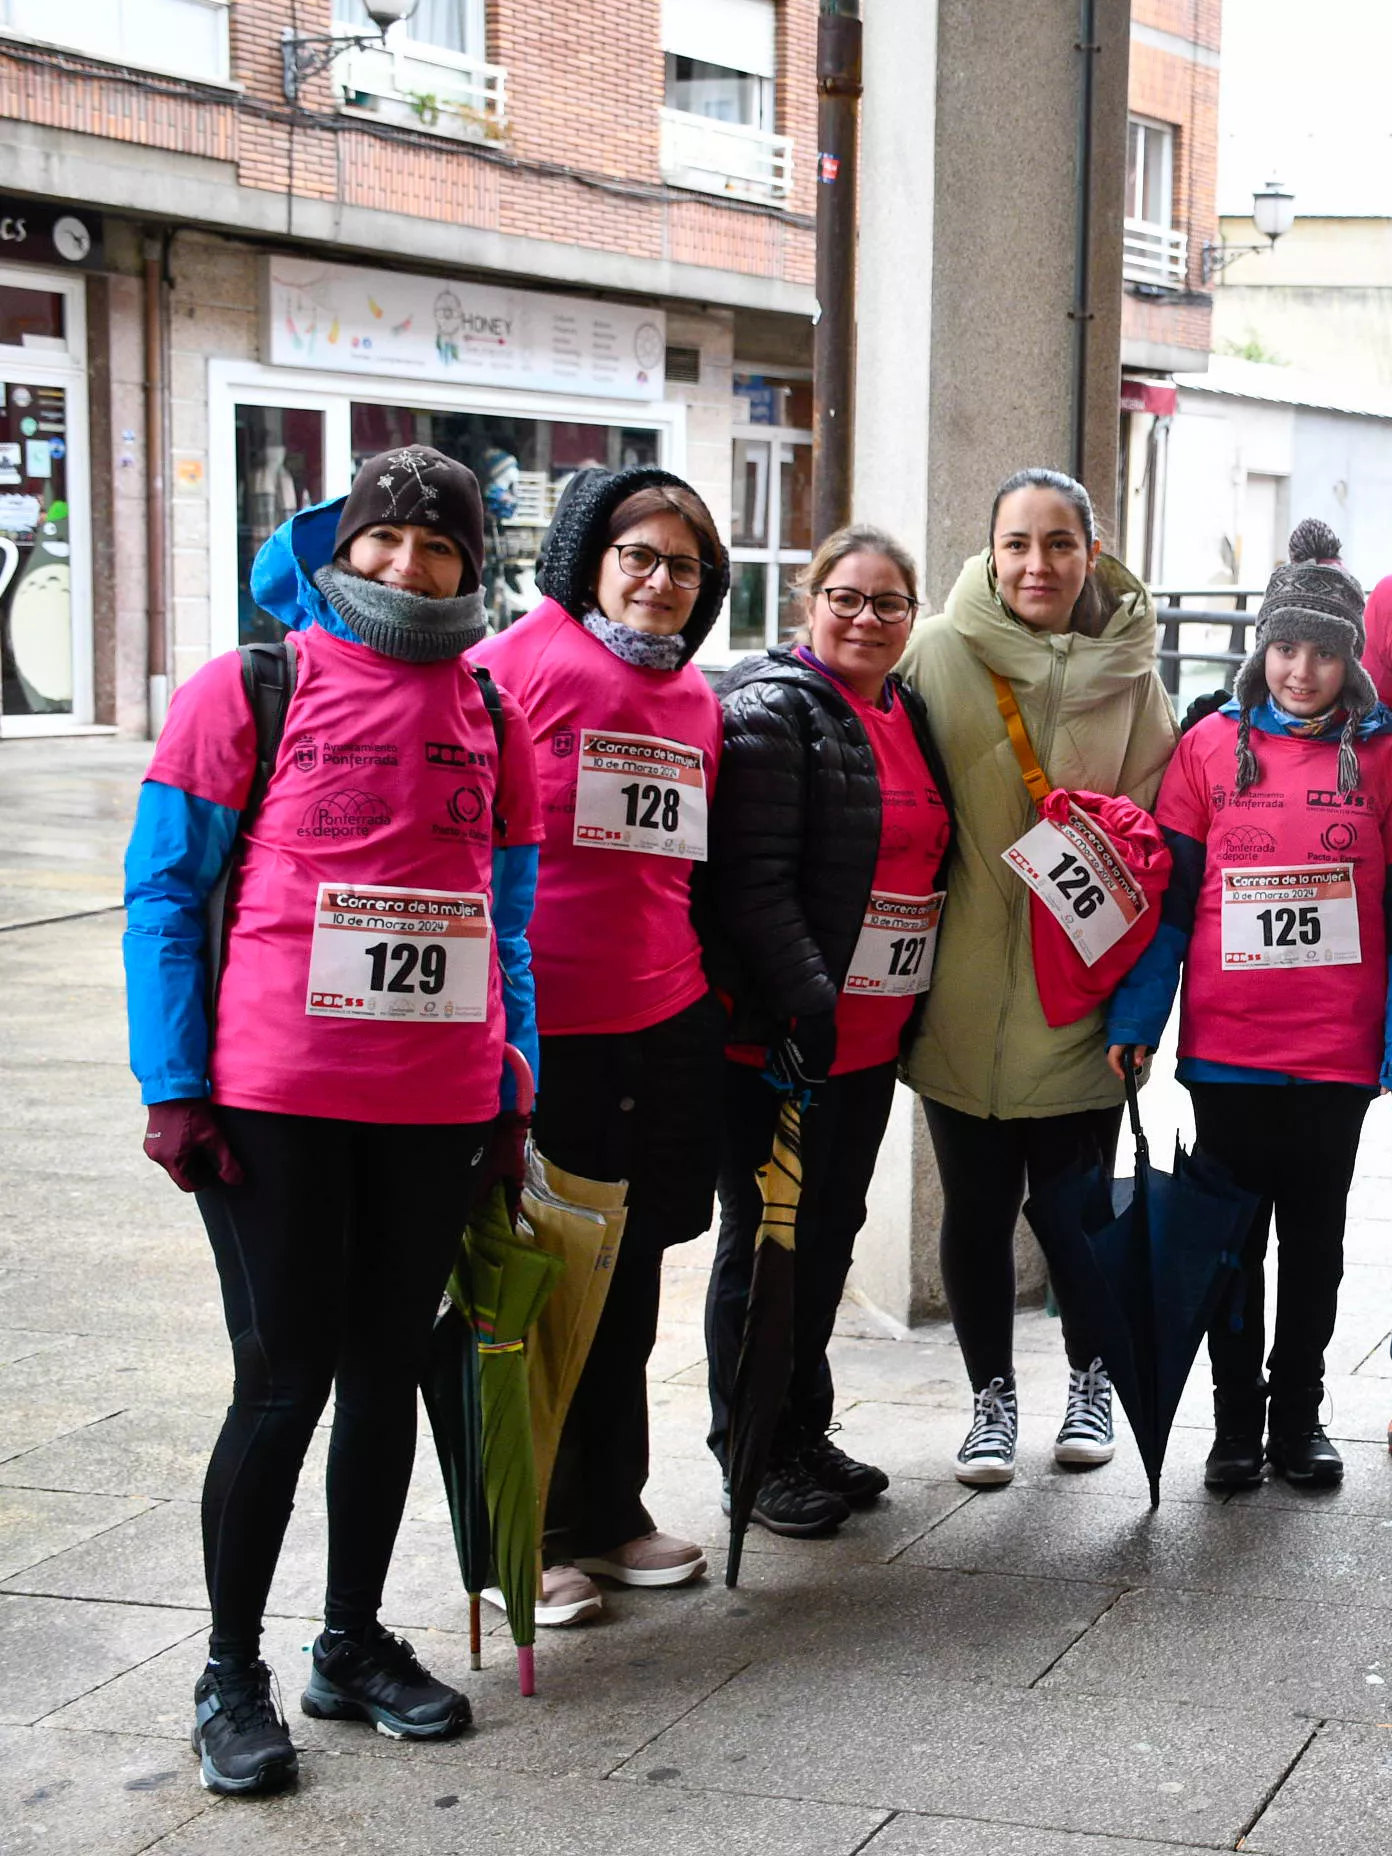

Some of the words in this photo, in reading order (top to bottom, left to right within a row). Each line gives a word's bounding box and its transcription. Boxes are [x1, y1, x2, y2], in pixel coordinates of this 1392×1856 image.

[460, 312, 512, 336] HONEY
[322, 754, 398, 768] Ponferrada
[597, 741, 651, 756] Carrera
[654, 749, 666, 759] de
[667, 752, 674, 762] la
[675, 755, 698, 769] mujer
[593, 758, 603, 767] 10
[606, 760, 619, 768] de
[622, 761, 659, 774] Marzo
[660, 766, 677, 777] 2024
[621, 783, 680, 832] 128
[1228, 798, 1284, 810] Ponferrada
[319, 808, 392, 826] Ponferrada
[1069, 815, 1104, 852] Carrera
[1103, 852, 1113, 866] de
[1112, 866, 1120, 878] la
[1076, 838, 1099, 868] Marzo
[1226, 839, 1275, 853] Ponferrada
[1047, 852, 1105, 919] 126
[1233, 876, 1279, 887] Carrera
[1282, 875, 1297, 885] de
[1299, 874, 1309, 884] la
[1311, 873, 1344, 885] mujer
[1233, 891, 1239, 900] 10
[1242, 892, 1252, 900] de
[1255, 891, 1289, 900] Marzo
[1291, 888, 1314, 898] 2024
[336, 893, 404, 911] Carrera
[408, 901, 426, 913] de
[428, 902, 438, 914] la
[440, 901, 477, 919] mujer
[875, 901, 918, 914] Carrera
[333, 913, 344, 924] 10
[347, 915, 363, 926] de
[366, 917, 415, 931] Marzo
[418, 920, 444, 932] 2024
[1256, 906, 1321, 947] 125
[365, 941, 447, 995] 129
